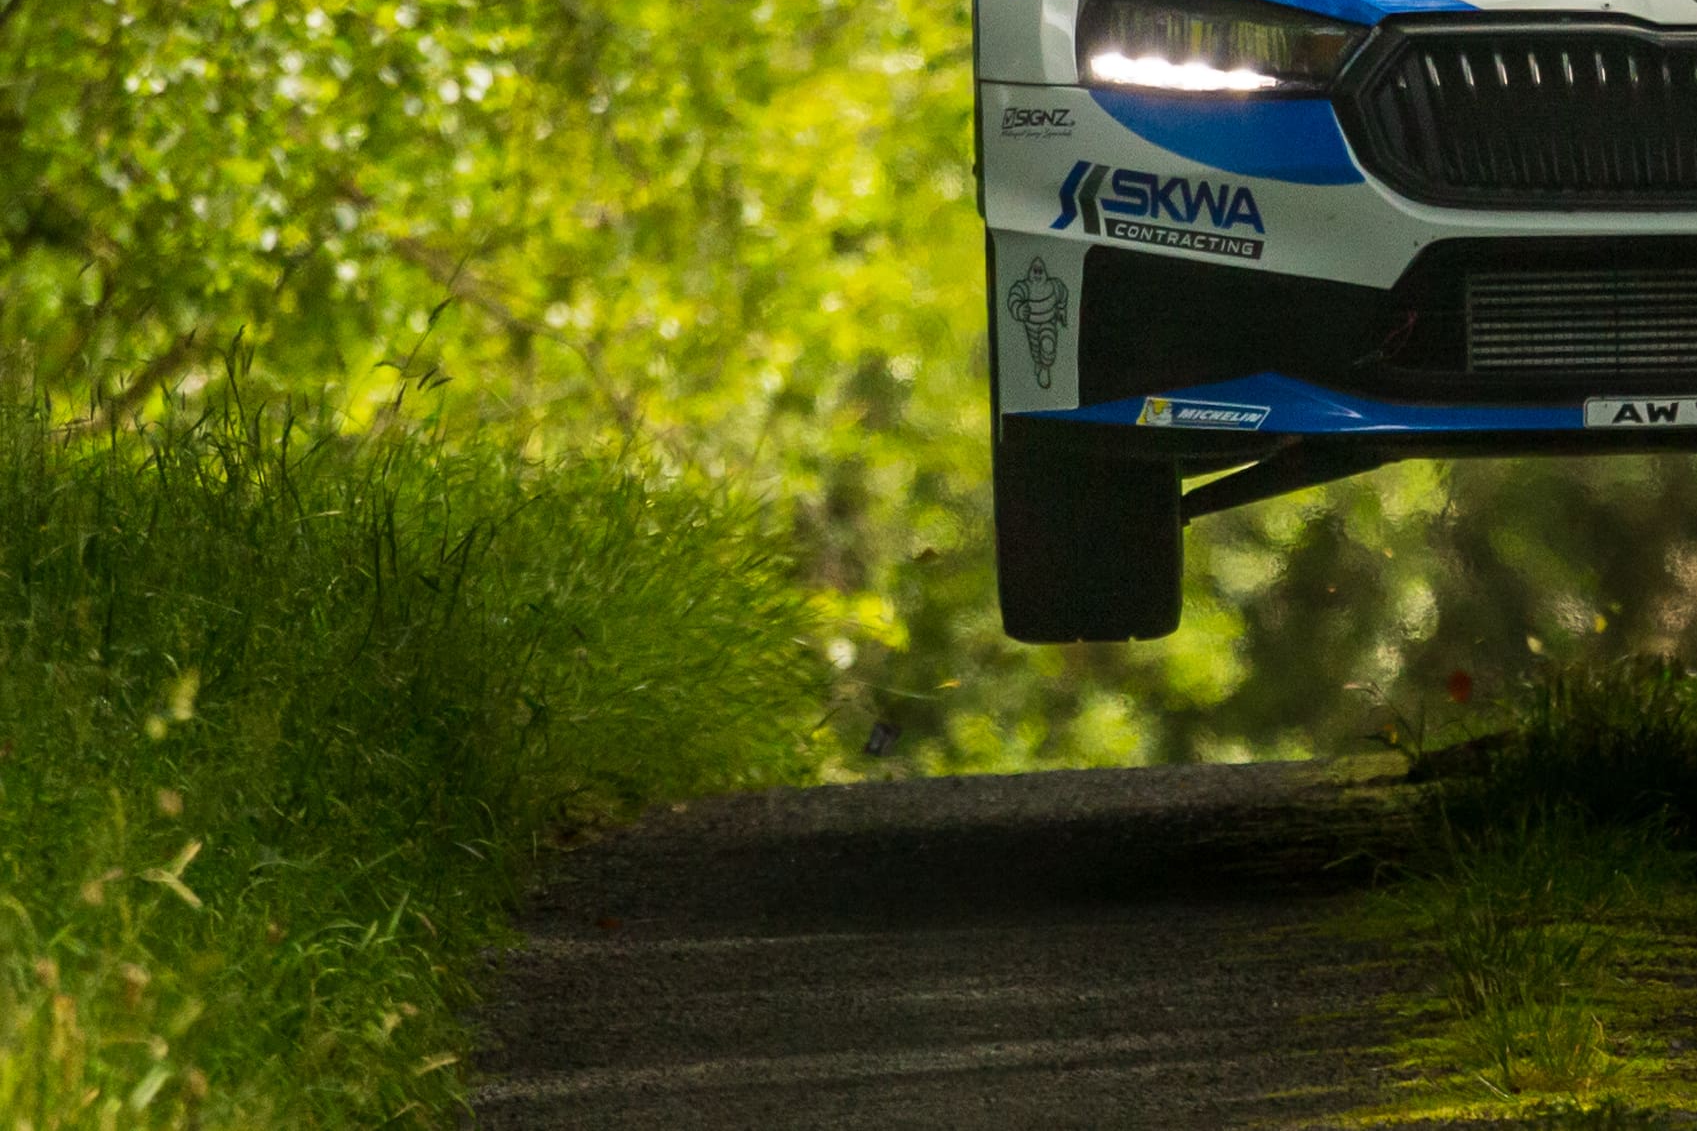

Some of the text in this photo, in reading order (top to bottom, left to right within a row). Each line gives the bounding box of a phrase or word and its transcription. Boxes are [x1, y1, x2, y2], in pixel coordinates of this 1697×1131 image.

[1100, 168, 1265, 234] SKWA
[1114, 222, 1255, 255] CONTRACTING
[1177, 408, 1263, 423] MICHELIN
[1611, 402, 1680, 424] AW
